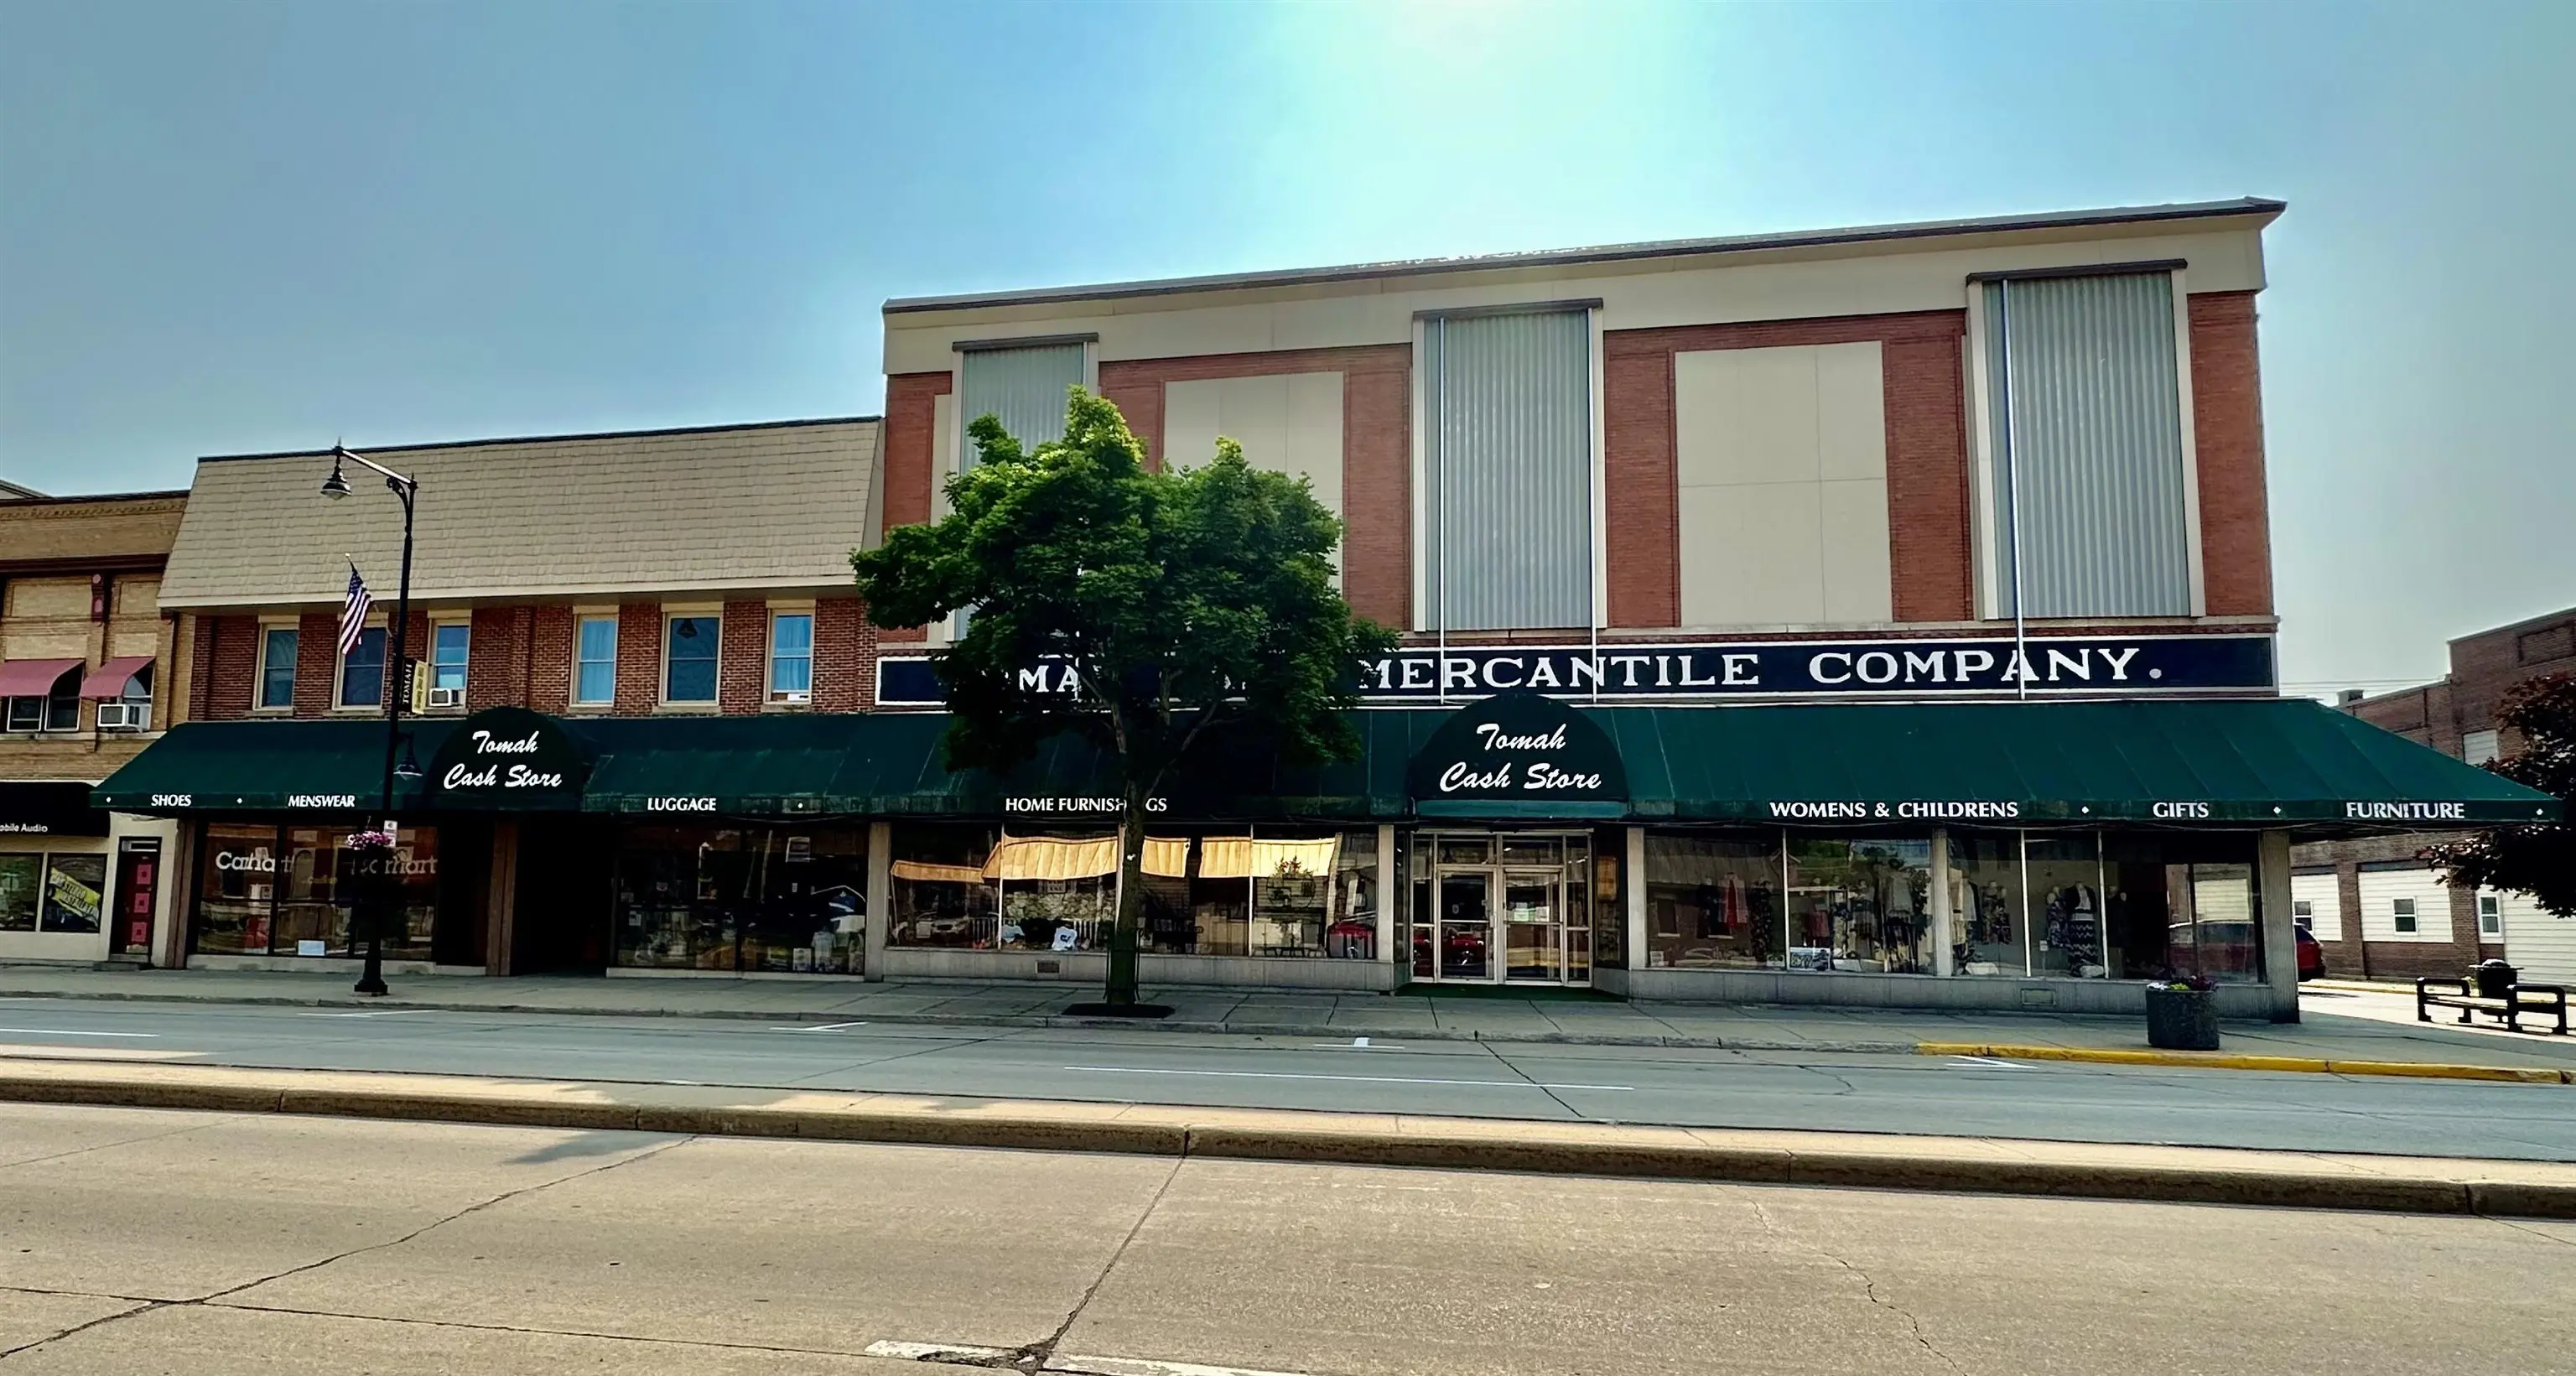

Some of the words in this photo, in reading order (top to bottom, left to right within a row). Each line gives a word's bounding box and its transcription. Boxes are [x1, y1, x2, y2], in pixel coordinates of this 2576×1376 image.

[1358, 654, 1759, 689] MERCANTILE
[1809, 647, 2162, 684] COMPANY.
[472, 730, 539, 754] Tomah
[1476, 723, 1566, 750] Tomah
[443, 763, 498, 790] Cash
[504, 764, 563, 787] Store
[1439, 761, 1512, 792] Cash
[1523, 762, 1602, 790] Store
[150, 794, 192, 807] SHOES
[288, 795, 356, 807] MENSWEAR
[647, 797, 717, 812] LUGGAGE
[1005, 797, 1054, 812] HOME
[1769, 802, 1867, 818] WOMENS
[1874, 802, 1890, 818] &
[1898, 802, 2019, 818] CHILDRENS
[2153, 802, 2210, 818] GIFTS
[2346, 802, 2465, 819] FURNITURE
[21, 823, 48, 833] Audio
